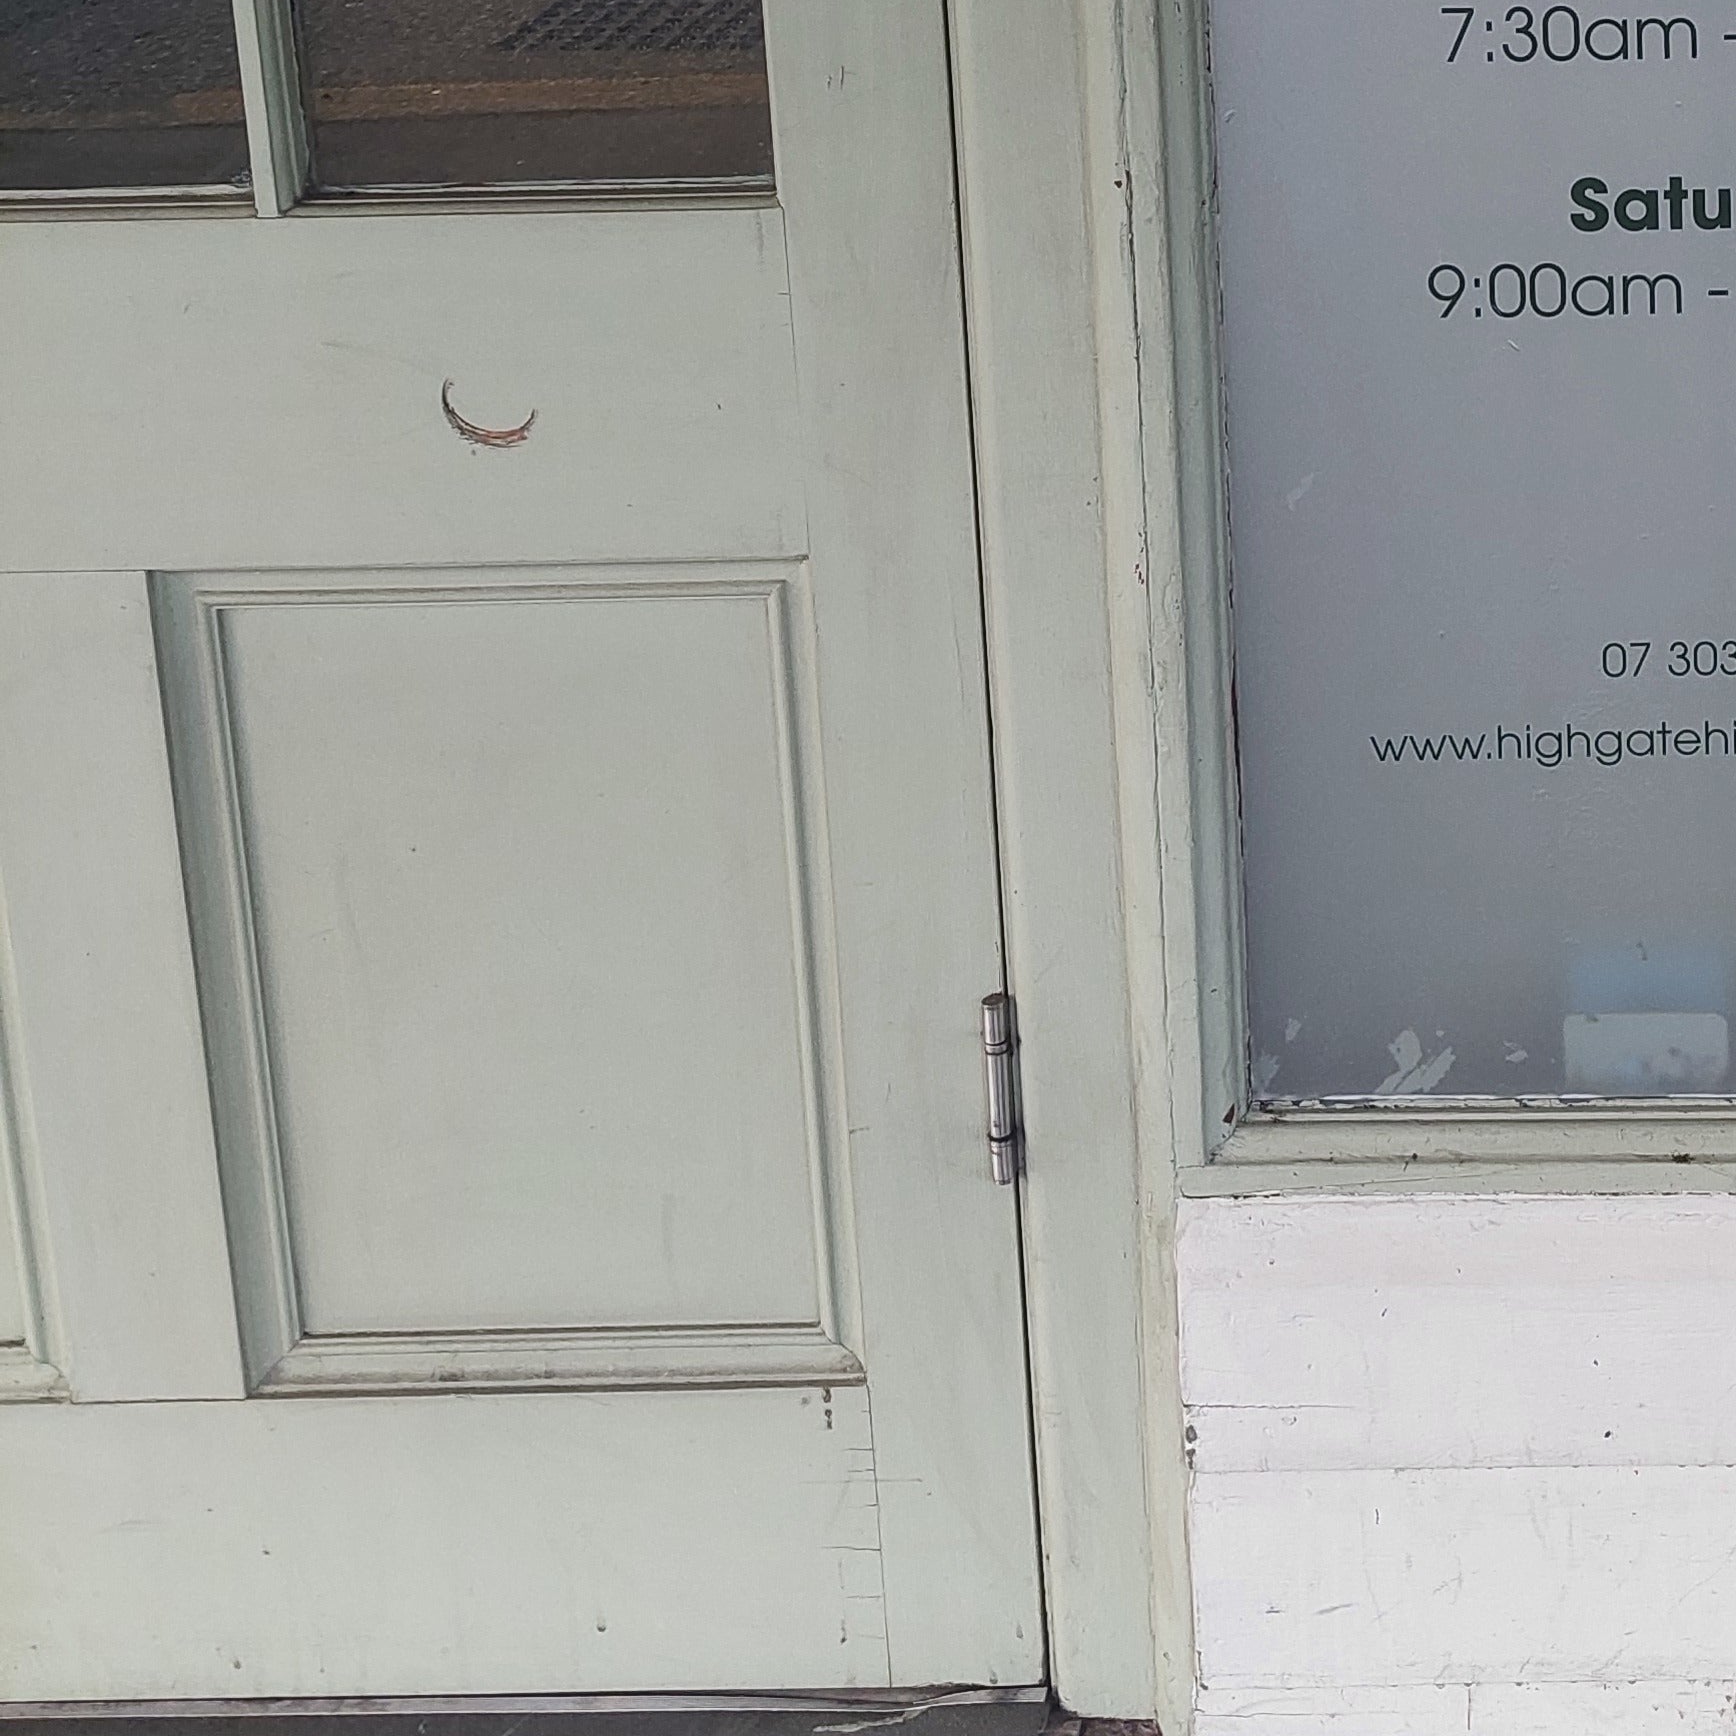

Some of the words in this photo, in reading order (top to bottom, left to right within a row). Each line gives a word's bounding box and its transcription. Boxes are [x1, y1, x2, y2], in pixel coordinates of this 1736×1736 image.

[1441, 6, 1697, 62] 7:30am
[1428, 263, 1682, 318] 9:00am
[1602, 642, 1651, 678] 07
